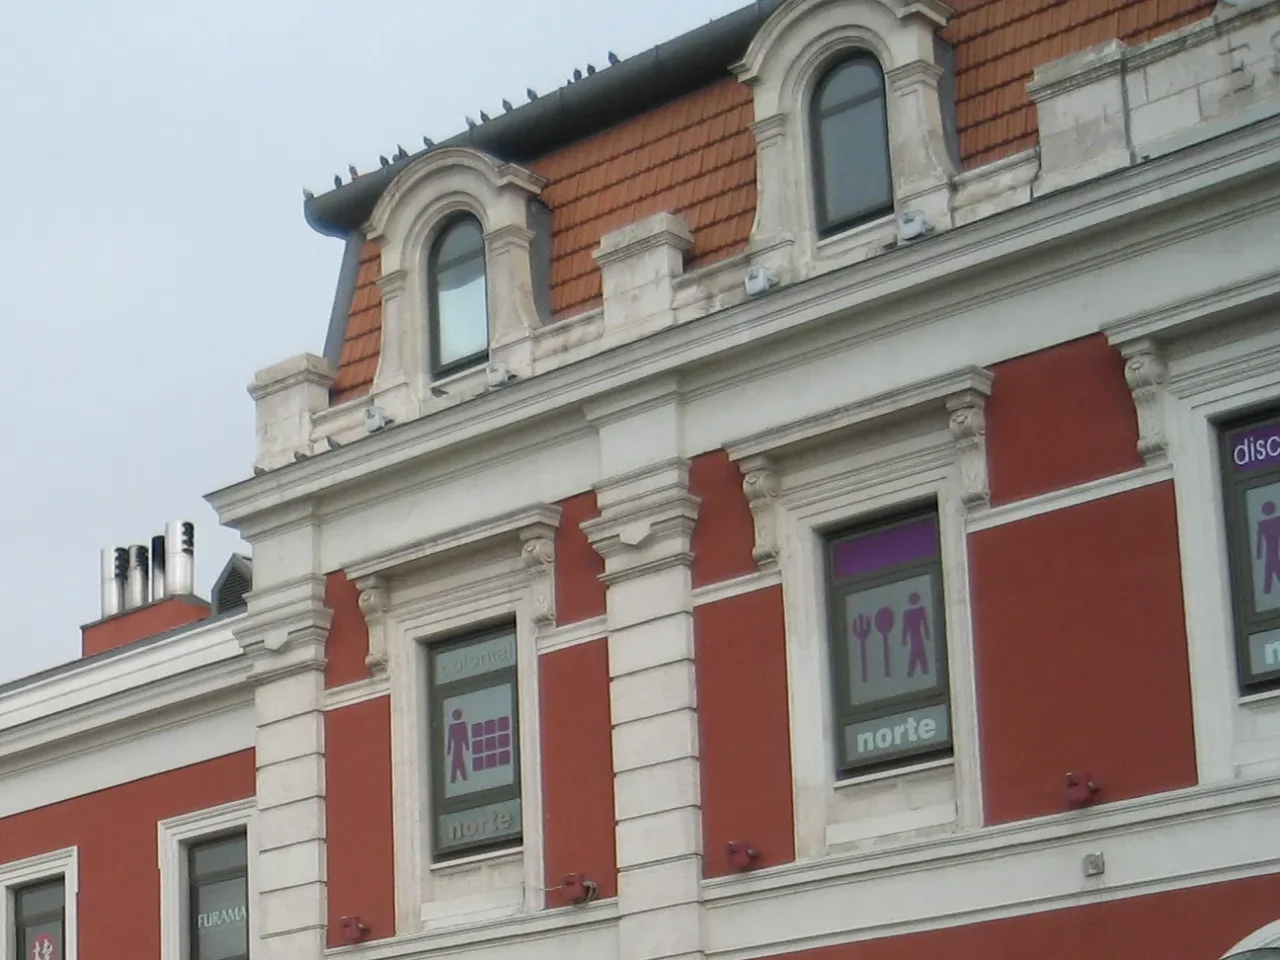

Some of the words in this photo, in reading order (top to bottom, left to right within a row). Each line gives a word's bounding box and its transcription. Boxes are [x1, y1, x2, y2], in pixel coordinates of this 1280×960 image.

[1233, 435, 1280, 466] disc
[856, 717, 937, 753] norte
[451, 810, 514, 841] norte
[198, 906, 246, 929] FURAMA
